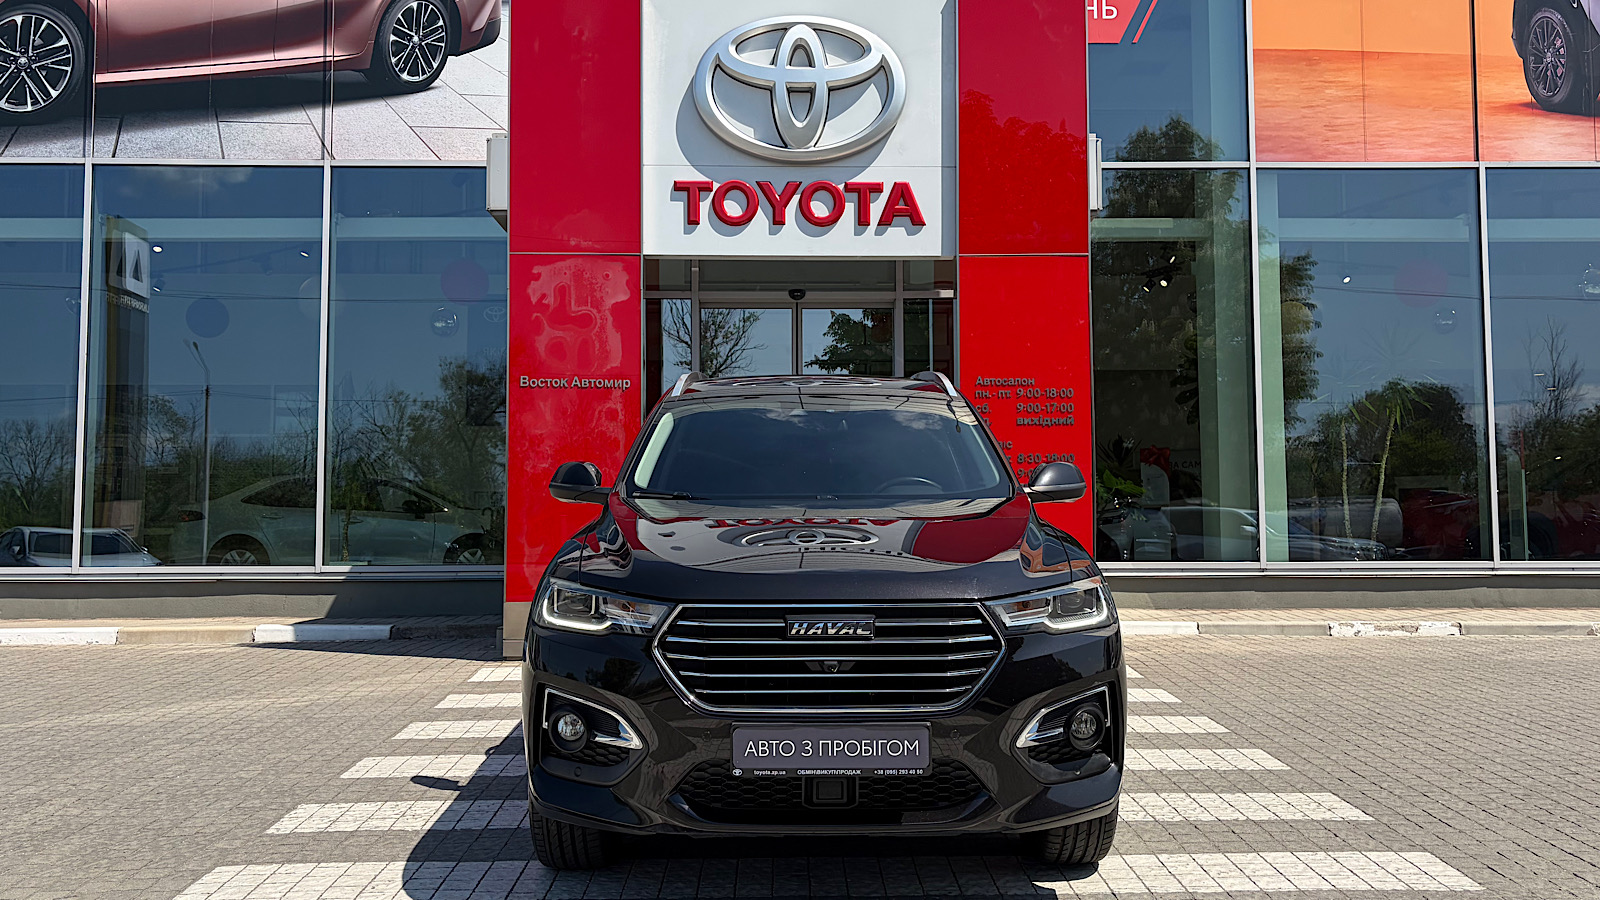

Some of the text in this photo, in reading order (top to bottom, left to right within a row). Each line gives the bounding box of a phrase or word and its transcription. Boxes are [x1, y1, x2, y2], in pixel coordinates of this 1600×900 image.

[673, 180, 926, 227] TOYOTA
[519, 376, 568, 388] Восток
[571, 376, 631, 391] Автомир
[975, 375, 1035, 386] Автосалон
[1016, 388, 1075, 398] 9:00-18:00
[1016, 402, 1075, 413] 9:00-17:00
[1016, 415, 1075, 428] вихідний
[1017, 453, 1076, 463] 8:30-18:00
[790, 622, 871, 635] HAVAL
[744, 739, 920, 757] АВТО З ПРОБІГОМ
